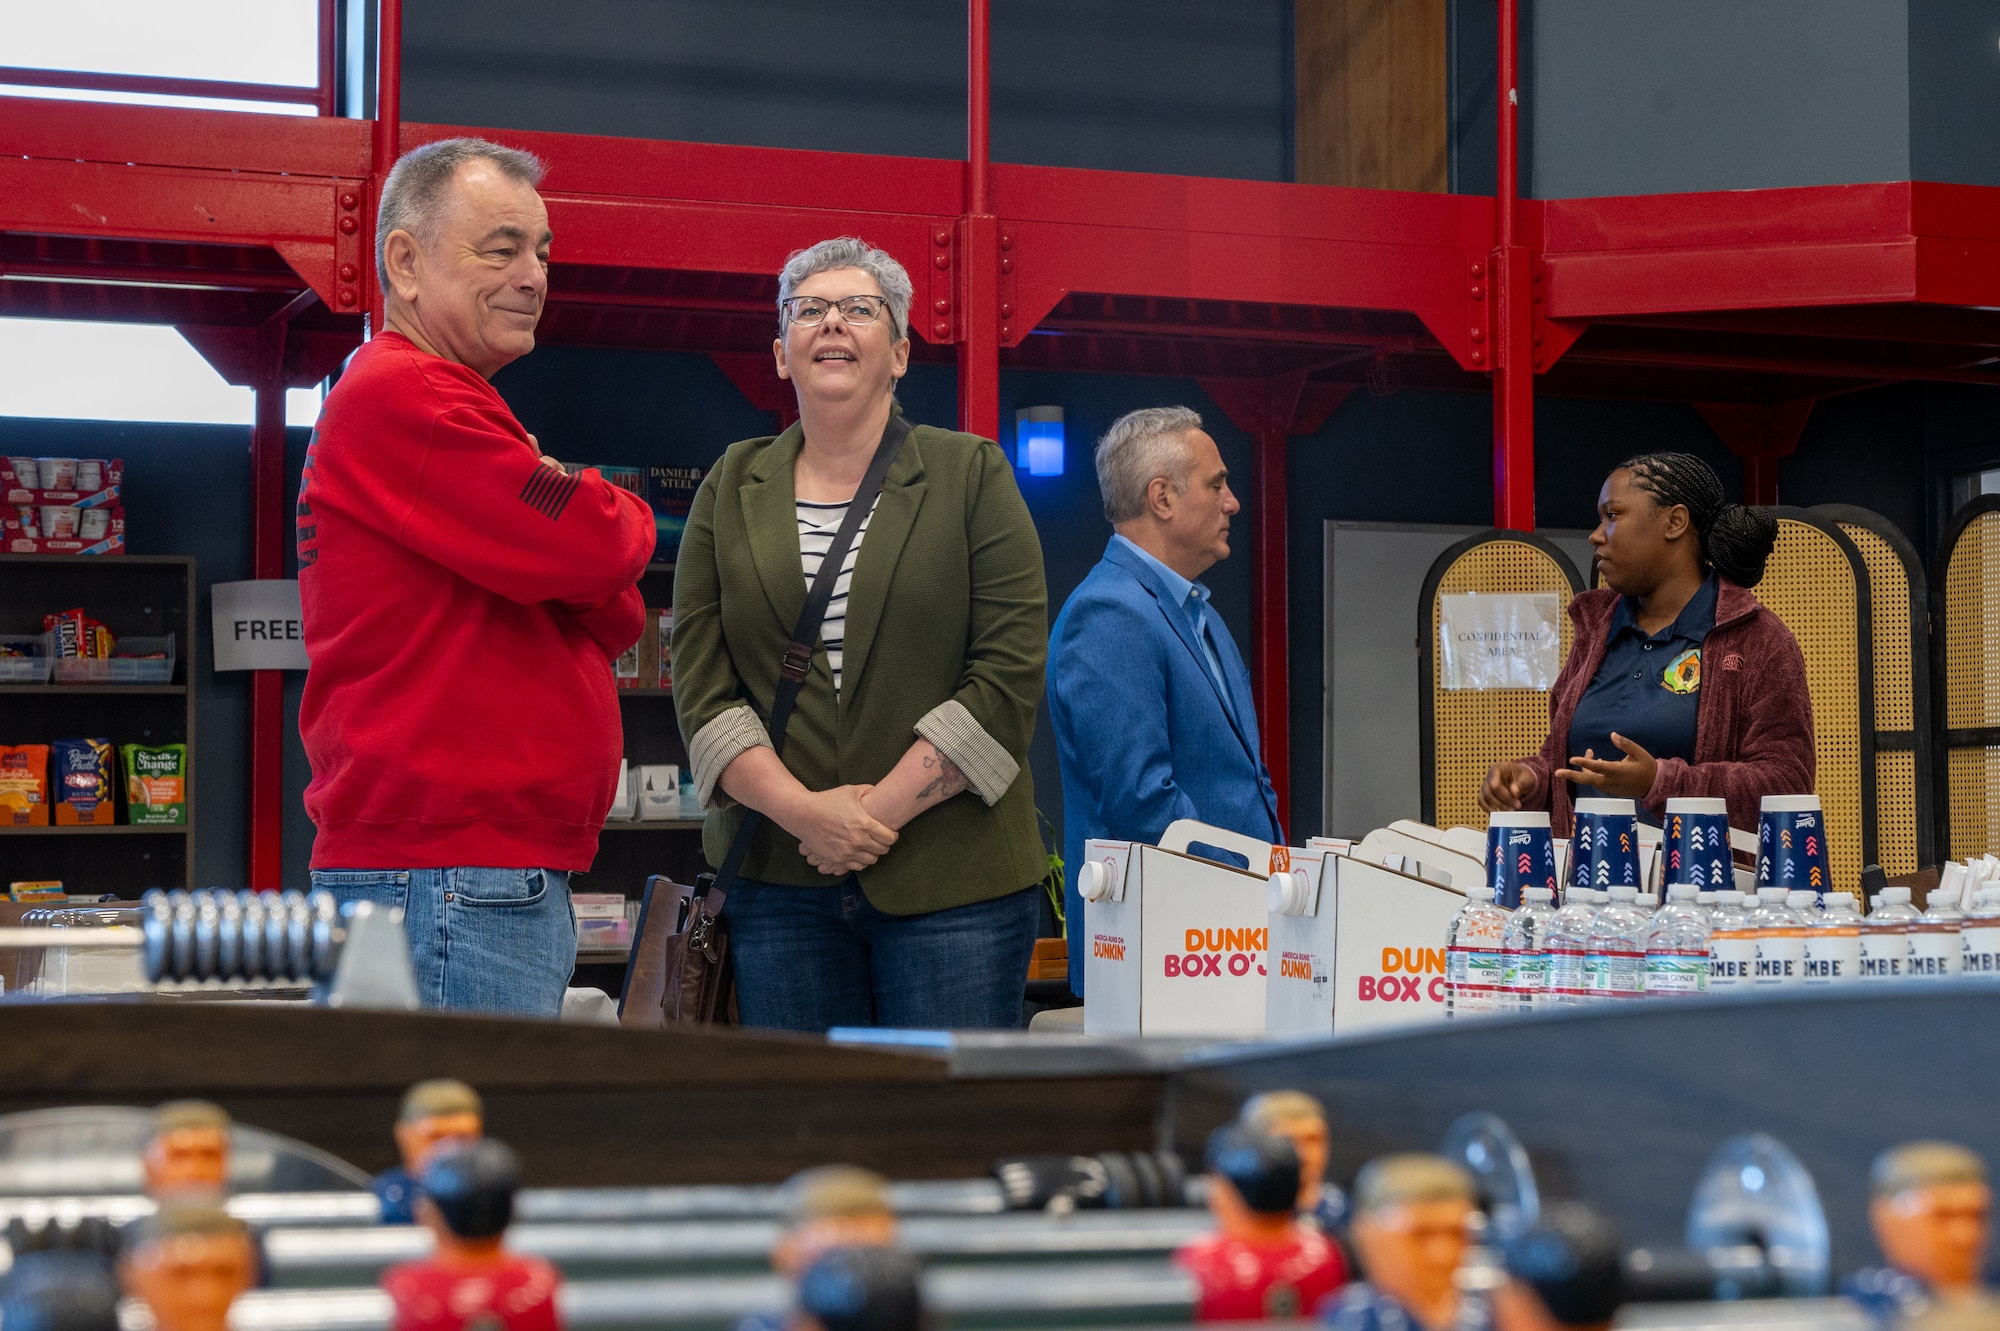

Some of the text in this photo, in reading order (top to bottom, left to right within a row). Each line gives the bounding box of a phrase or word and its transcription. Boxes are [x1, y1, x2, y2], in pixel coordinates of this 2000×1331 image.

[108, 471, 121, 480] 12
[650, 467, 703, 479] DANIELE
[661, 479, 694, 489] STEEL
[112, 520, 124, 529] 12
[1458, 631, 1543, 642] CONFIDENTIAL
[1487, 647, 1516, 657] AREA
[68, 748, 100, 763] Ready
[138, 751, 171, 760] Seeds
[70, 760, 95, 771] Pasta
[137, 760, 178, 771] Change
[1094, 934, 1108, 942] AMERICA
[1094, 941, 1126, 961] DUNKIN'
[1164, 954, 1222, 977] BOX
[1359, 976, 1421, 1002] BOX
